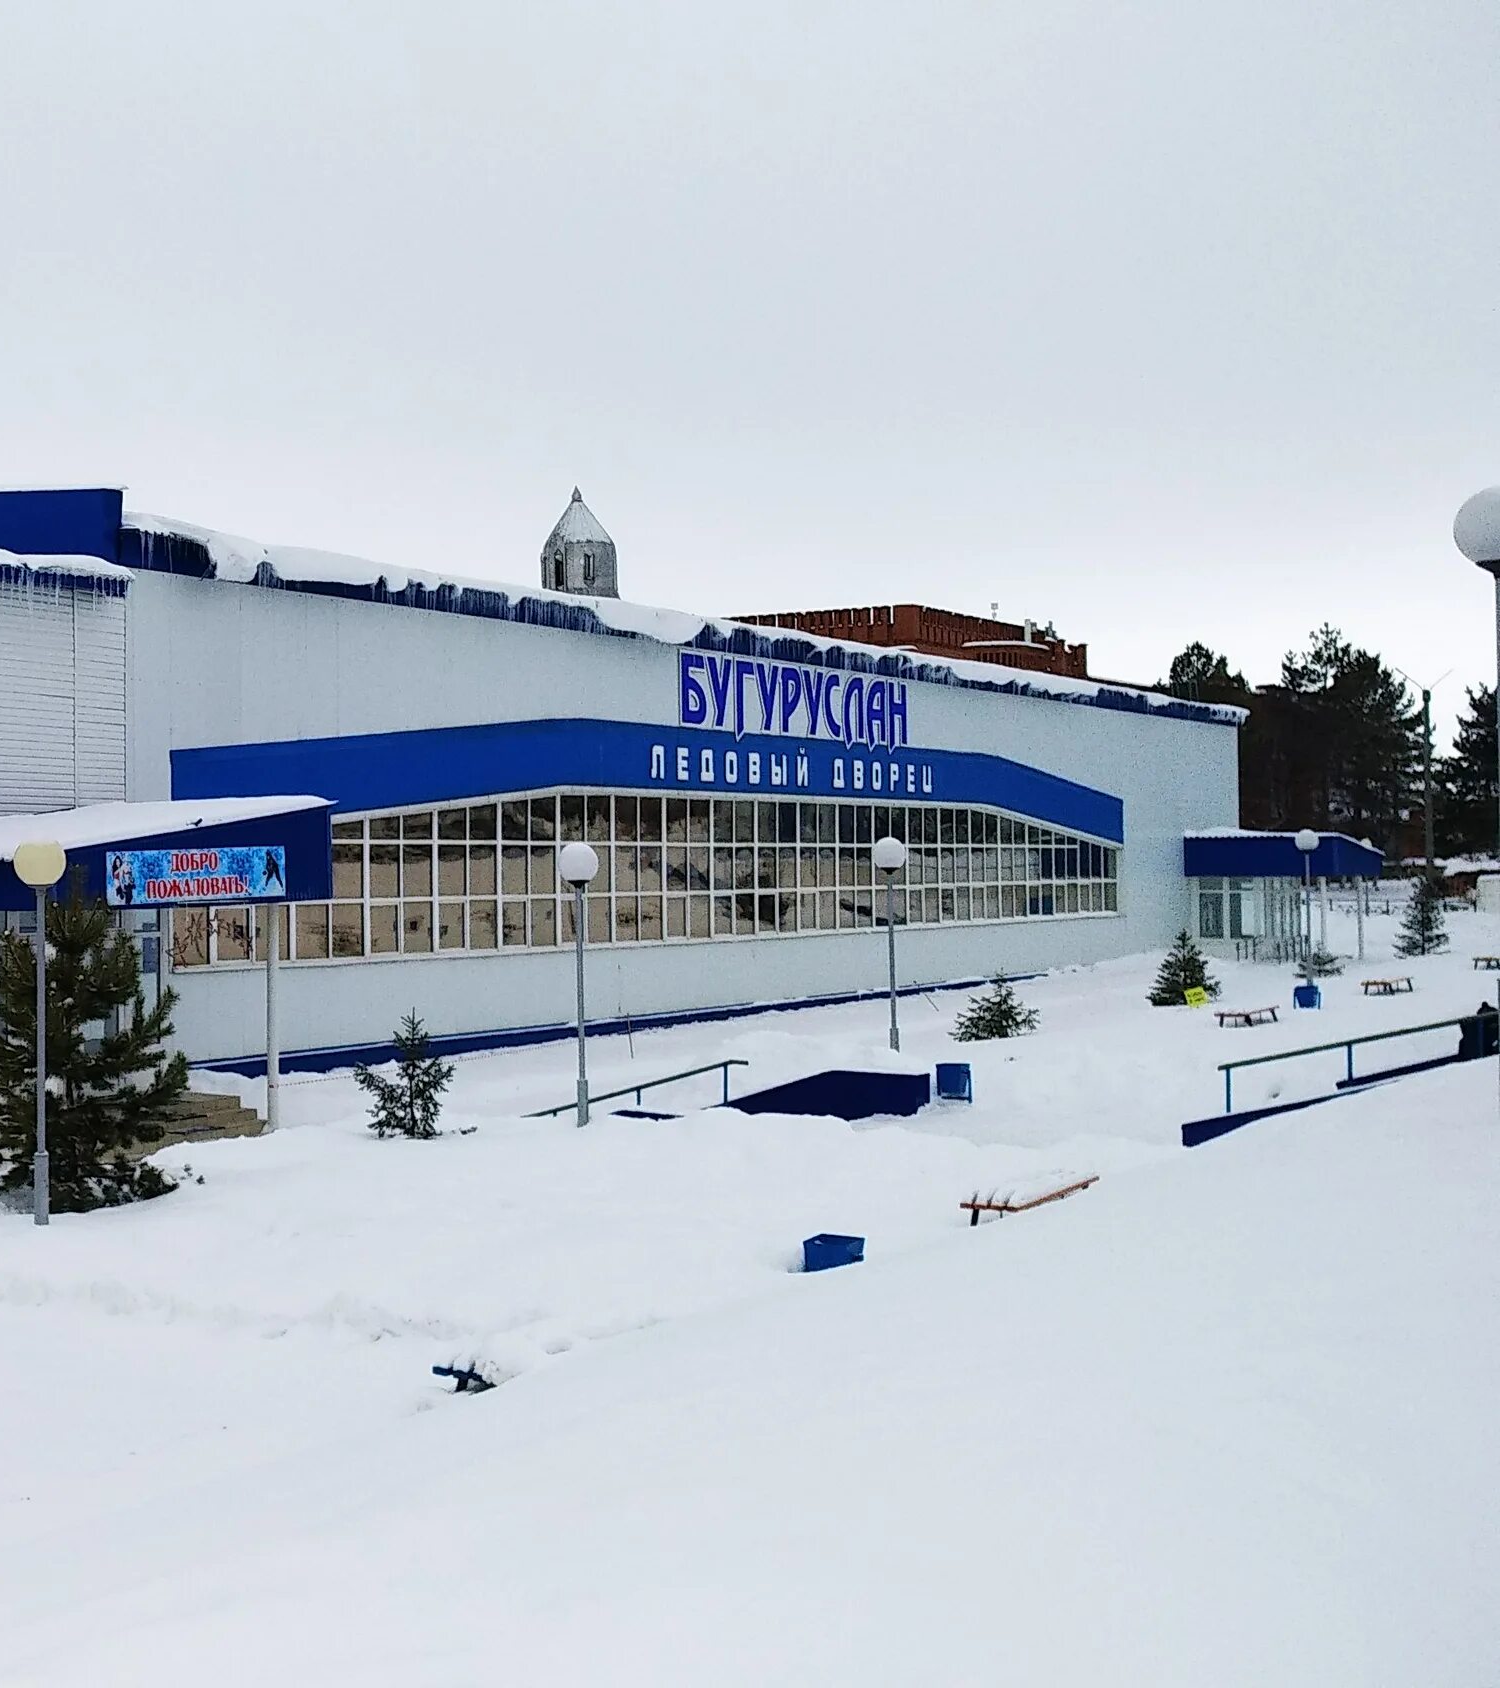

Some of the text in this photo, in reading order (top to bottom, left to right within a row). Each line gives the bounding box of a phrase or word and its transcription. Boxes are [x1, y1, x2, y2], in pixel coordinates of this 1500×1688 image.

[678, 649, 908, 755] БУГУРУСЛАН
[650, 744, 934, 793] ЛЕДОВЫЙ ДВОРЕЦ
[170, 852, 219, 873] ДОБРО
[146, 875, 250, 900] ПОЖАЛОВАТЬ!
